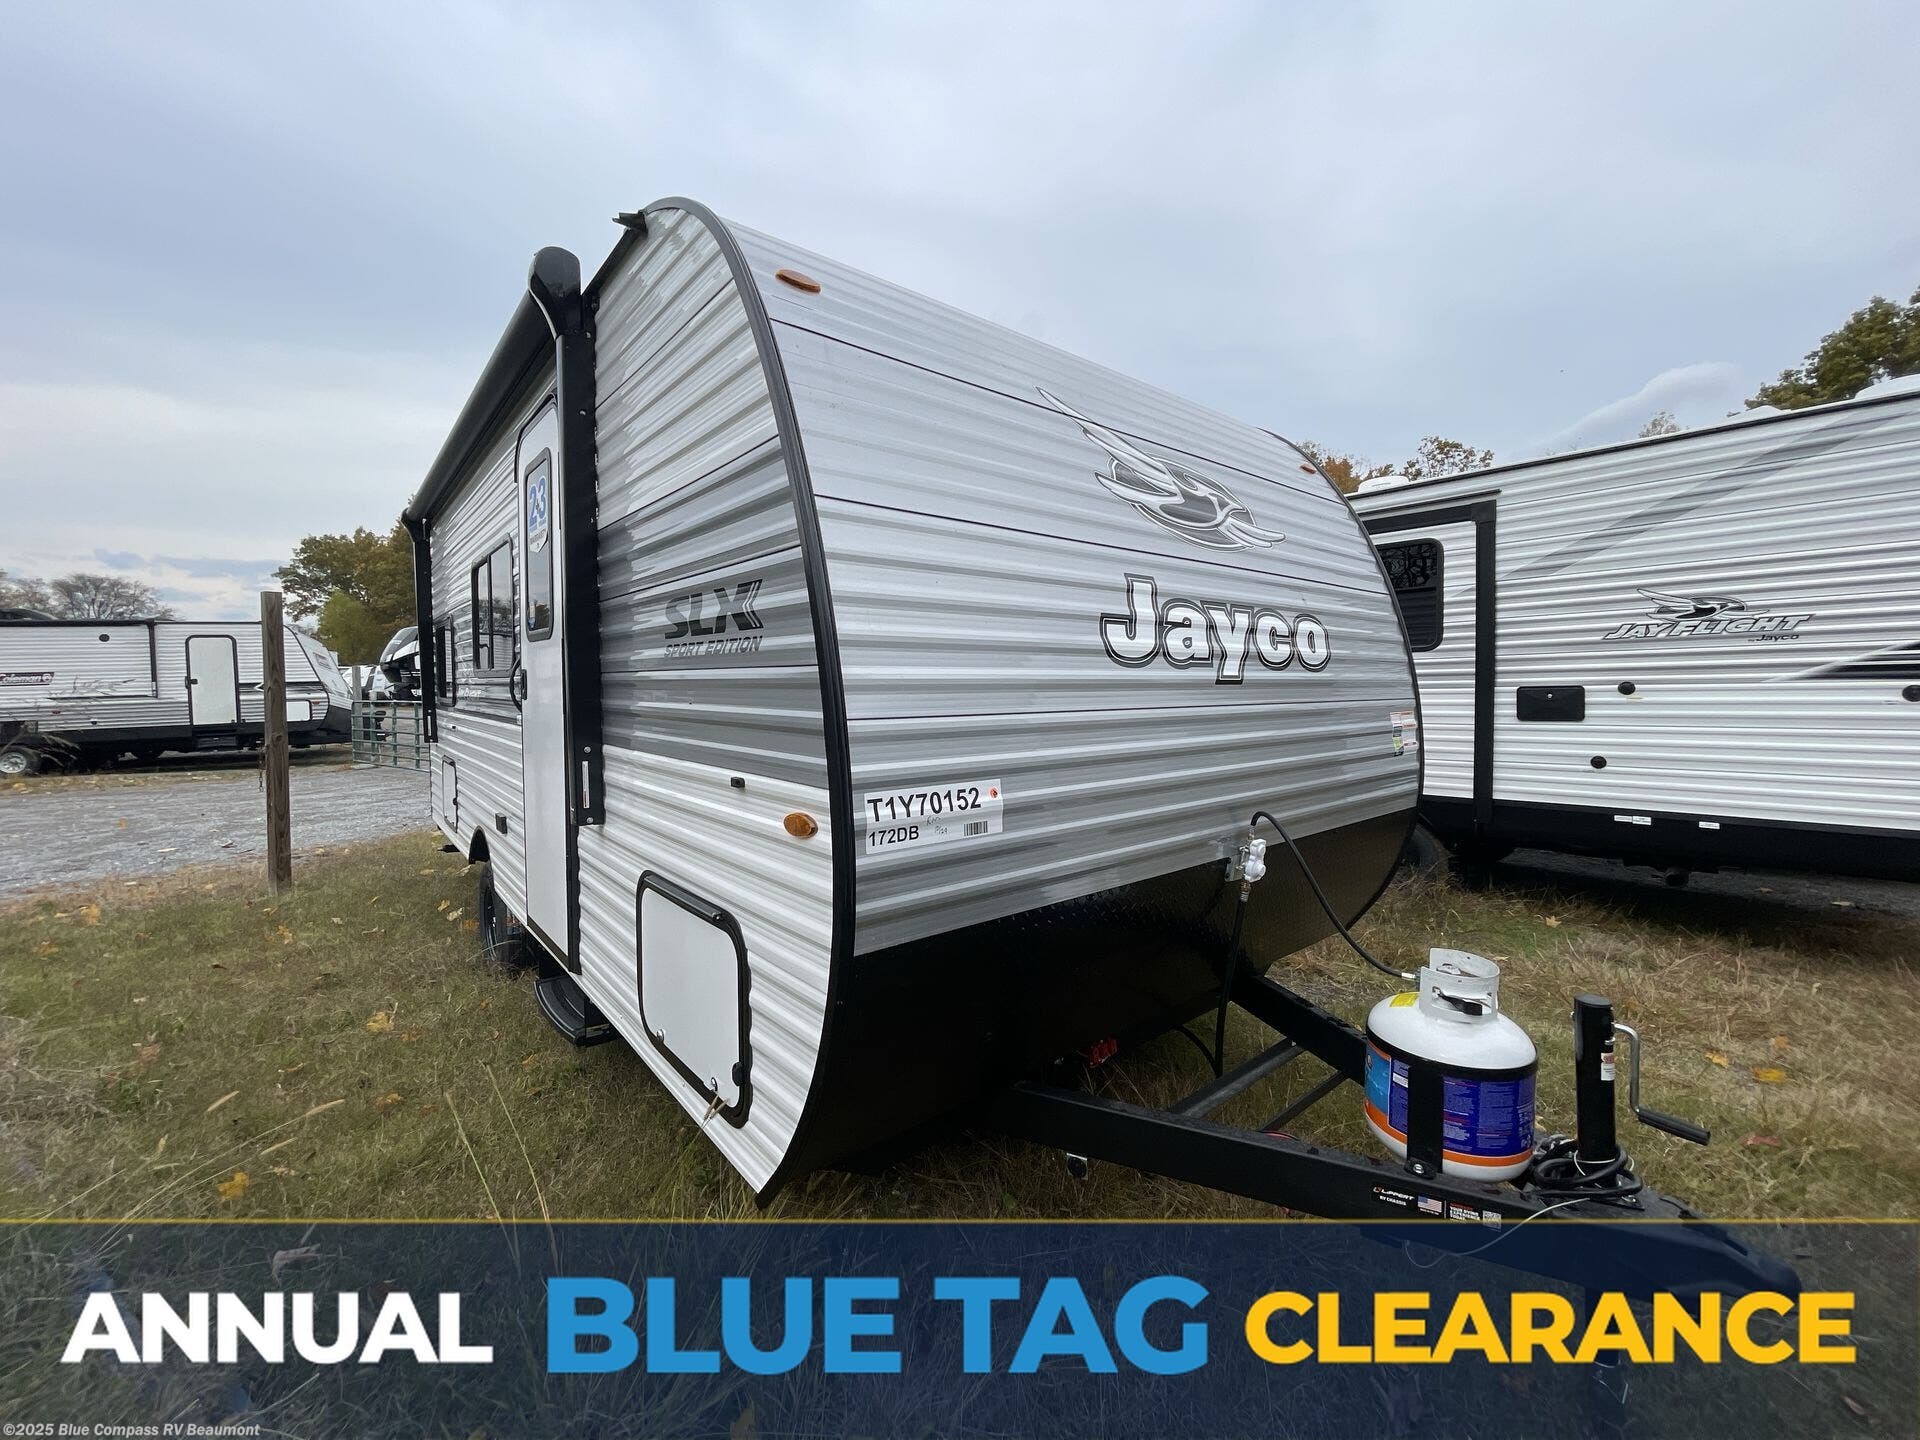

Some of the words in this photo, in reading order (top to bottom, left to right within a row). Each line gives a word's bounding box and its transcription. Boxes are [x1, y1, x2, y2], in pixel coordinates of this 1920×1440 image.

[665, 579, 763, 639] SLX
[1100, 573, 1331, 685] Jayco
[1602, 623, 1676, 640] JAY
[1668, 613, 1815, 637] FLIGHT
[1756, 634, 1799, 642] Jayco
[664, 642, 705, 657] SPORT
[705, 636, 763, 655] EDITION
[867, 787, 981, 822] T1Y70152
[868, 826, 919, 846] 172DB
